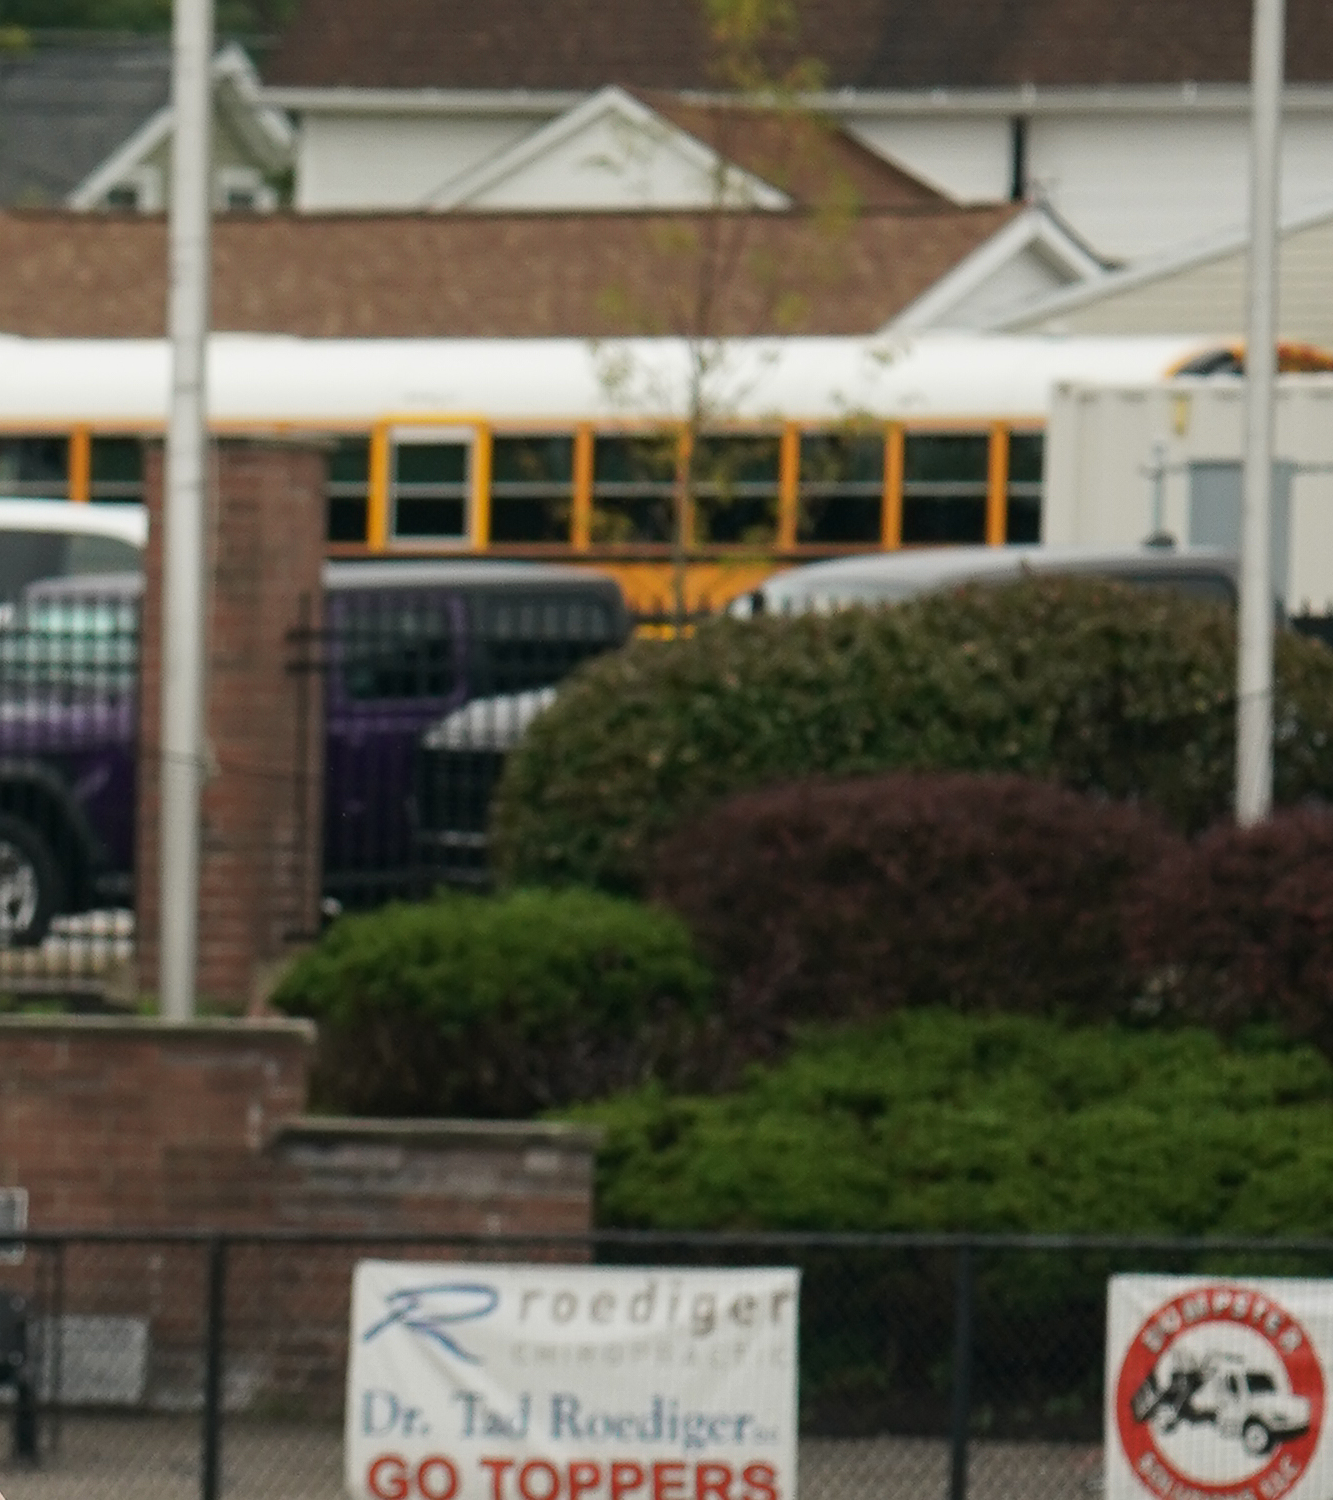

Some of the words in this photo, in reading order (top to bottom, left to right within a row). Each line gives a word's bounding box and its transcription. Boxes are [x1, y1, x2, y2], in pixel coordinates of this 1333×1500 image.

[517, 1274, 791, 1337] roediger
[362, 1390, 429, 1437] Dr.
[453, 1389, 531, 1438] Tad
[550, 1392, 754, 1449] Roediger
